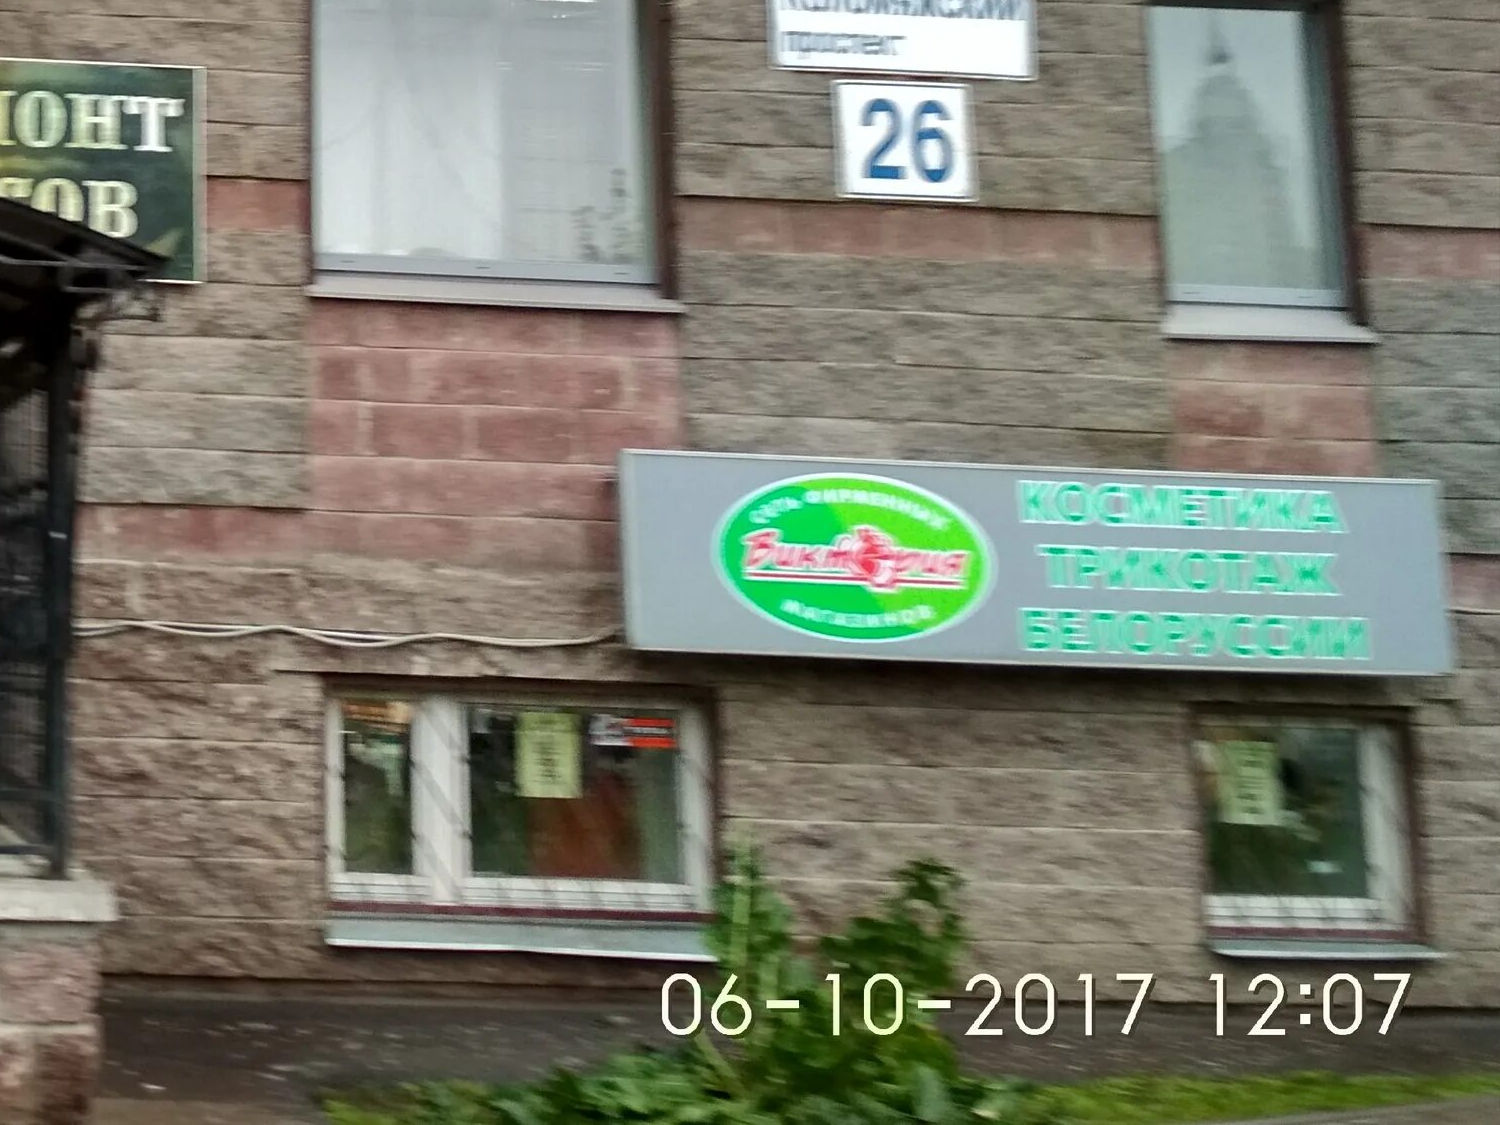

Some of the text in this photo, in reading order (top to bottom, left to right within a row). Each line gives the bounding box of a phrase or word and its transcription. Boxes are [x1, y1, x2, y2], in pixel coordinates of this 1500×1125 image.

[860, 98, 955, 183] 26
[1016, 479, 1349, 534] КОСМЕТИКА
[1035, 544, 1343, 596] ТРИКОТАЖ
[1017, 607, 1372, 661] БЕЛОРУССИИ
